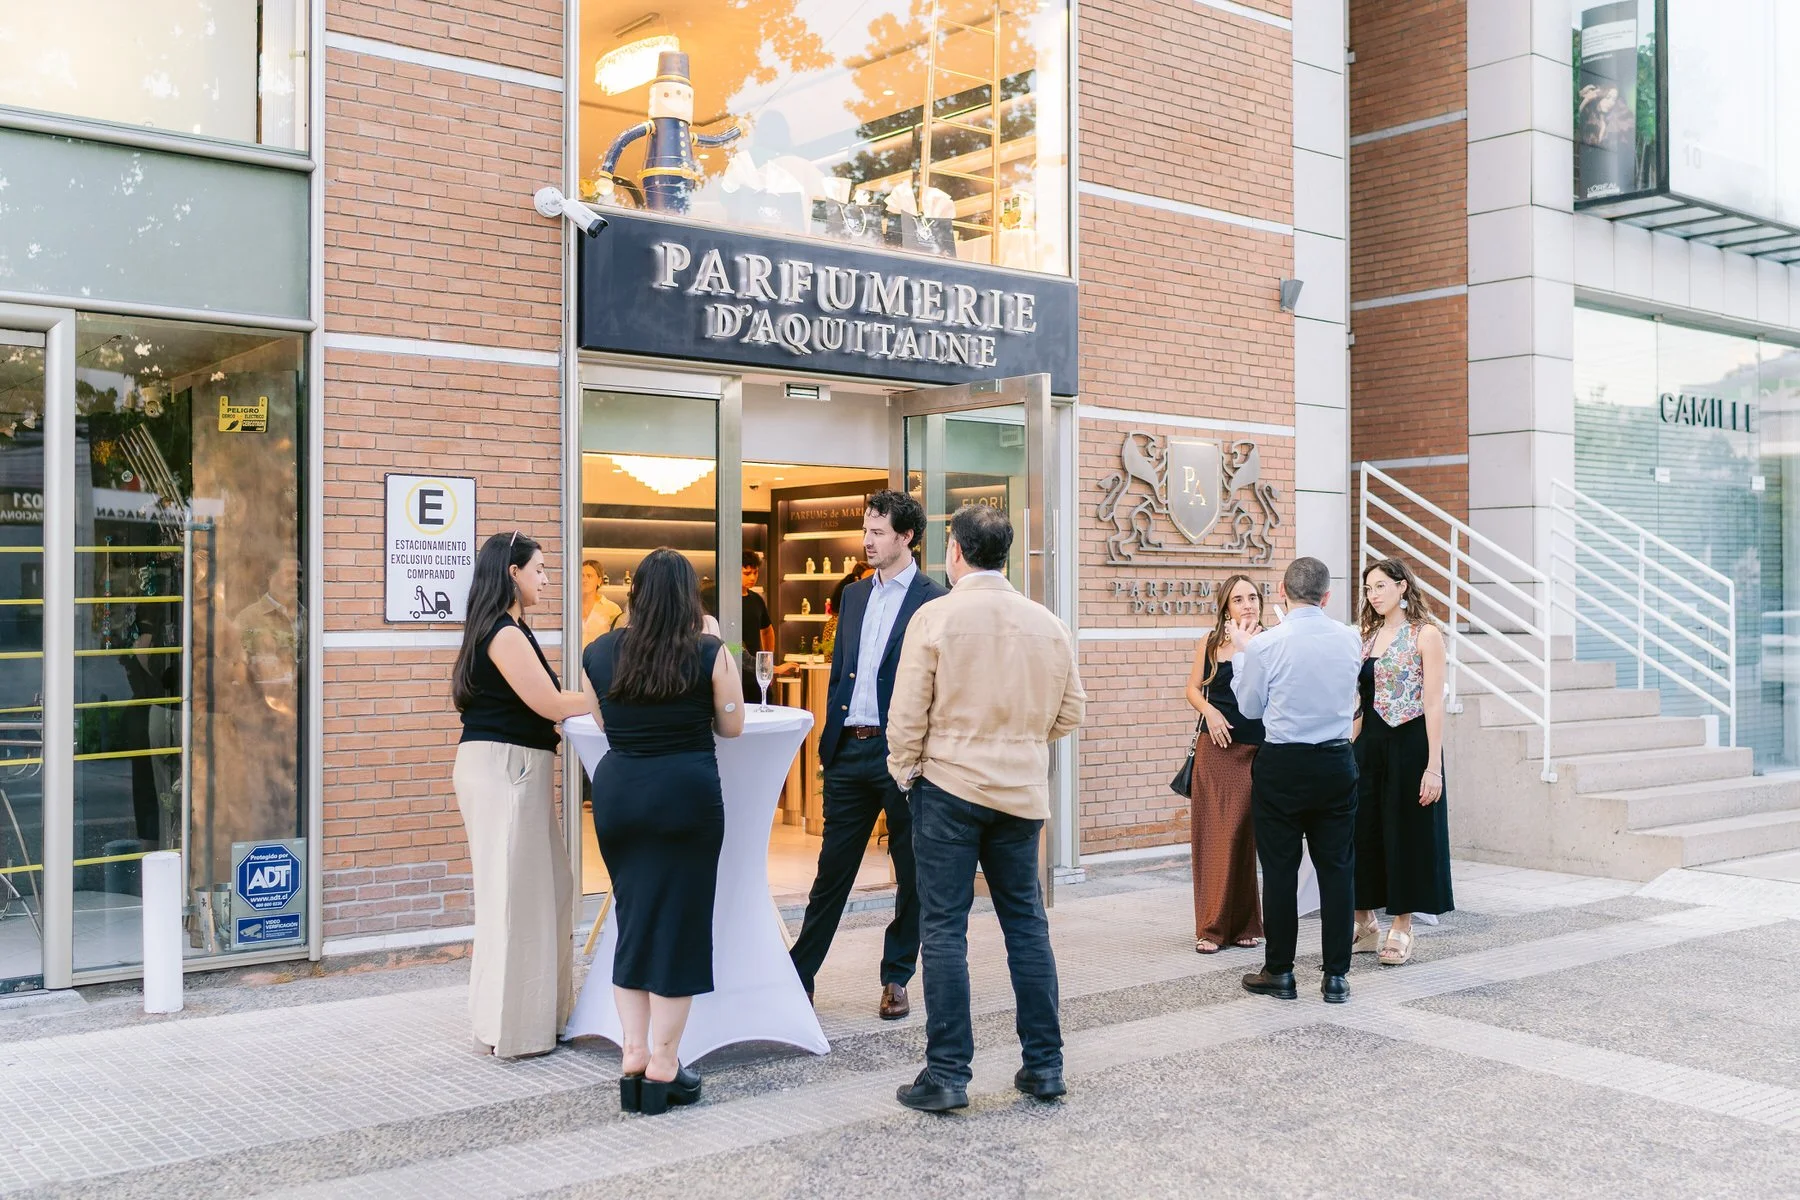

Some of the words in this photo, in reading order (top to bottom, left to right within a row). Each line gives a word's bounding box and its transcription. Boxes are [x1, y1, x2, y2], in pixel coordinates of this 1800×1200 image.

[655, 241, 1039, 334] PARFUMERIE
[709, 302, 999, 368] D'AQUITAINE
[418, 488, 444, 525] E
[790, 508, 828, 520] PARFUMS
[395, 539, 467, 552] ESTACIONAMIENTO
[391, 554, 432, 565] EXCLUSIVO
[435, 555, 471, 566] CLIENTES
[407, 568, 455, 580] COMPRANDO
[1112, 581, 1271, 598] PARFUME
[248, 865, 290, 890] ADT
[250, 894, 288, 903] www.adt.cl
